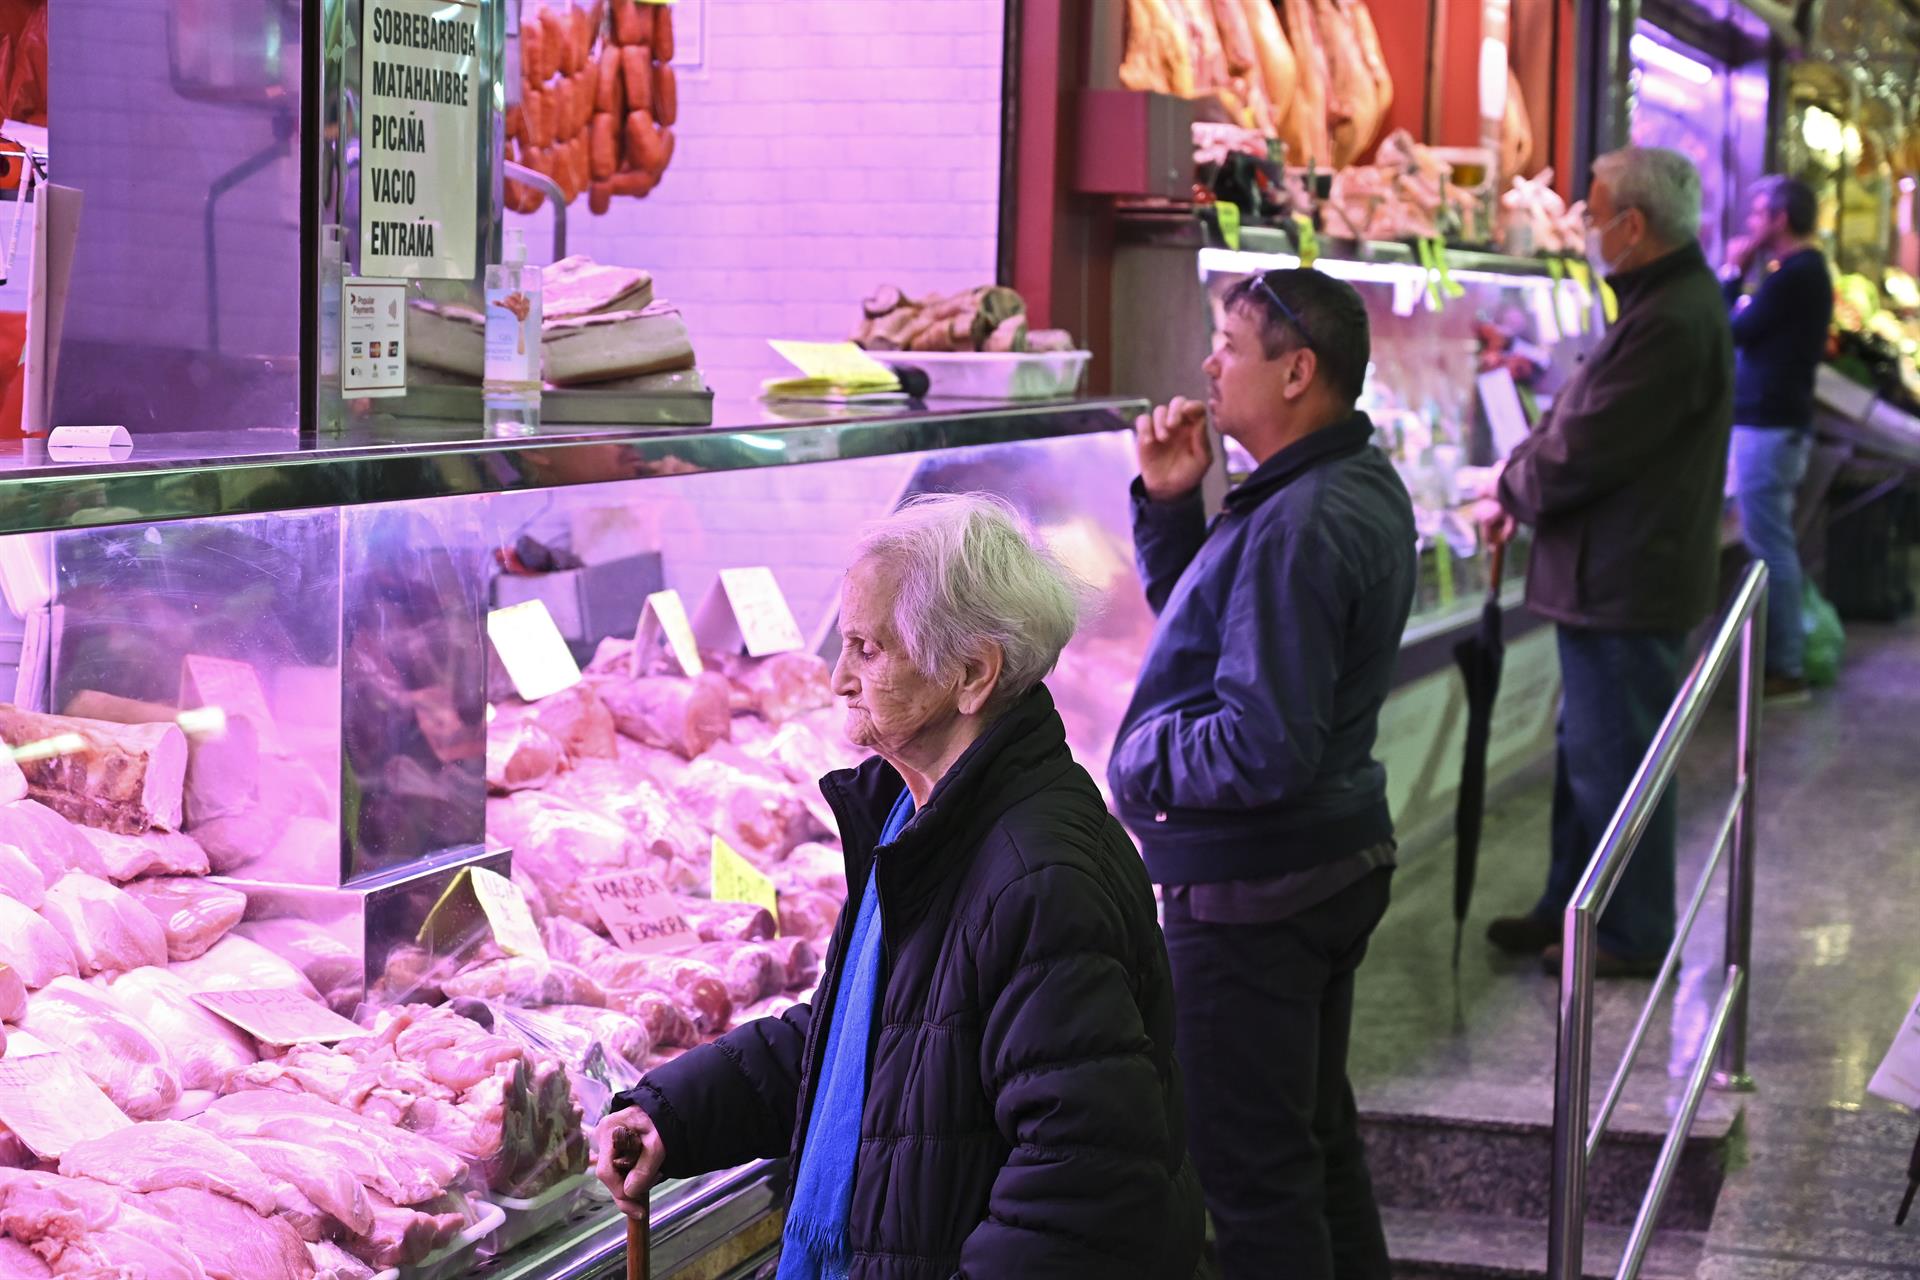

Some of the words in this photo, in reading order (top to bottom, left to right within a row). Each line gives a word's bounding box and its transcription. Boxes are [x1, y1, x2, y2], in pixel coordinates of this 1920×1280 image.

[373, 7, 476, 57] SOBREBARRIGA
[372, 61, 469, 107] MATAHAMBRE
[372, 110, 426, 153] PICAÑA
[371, 167, 416, 205] VACIO
[371, 216, 434, 257] ENTRAÑA
